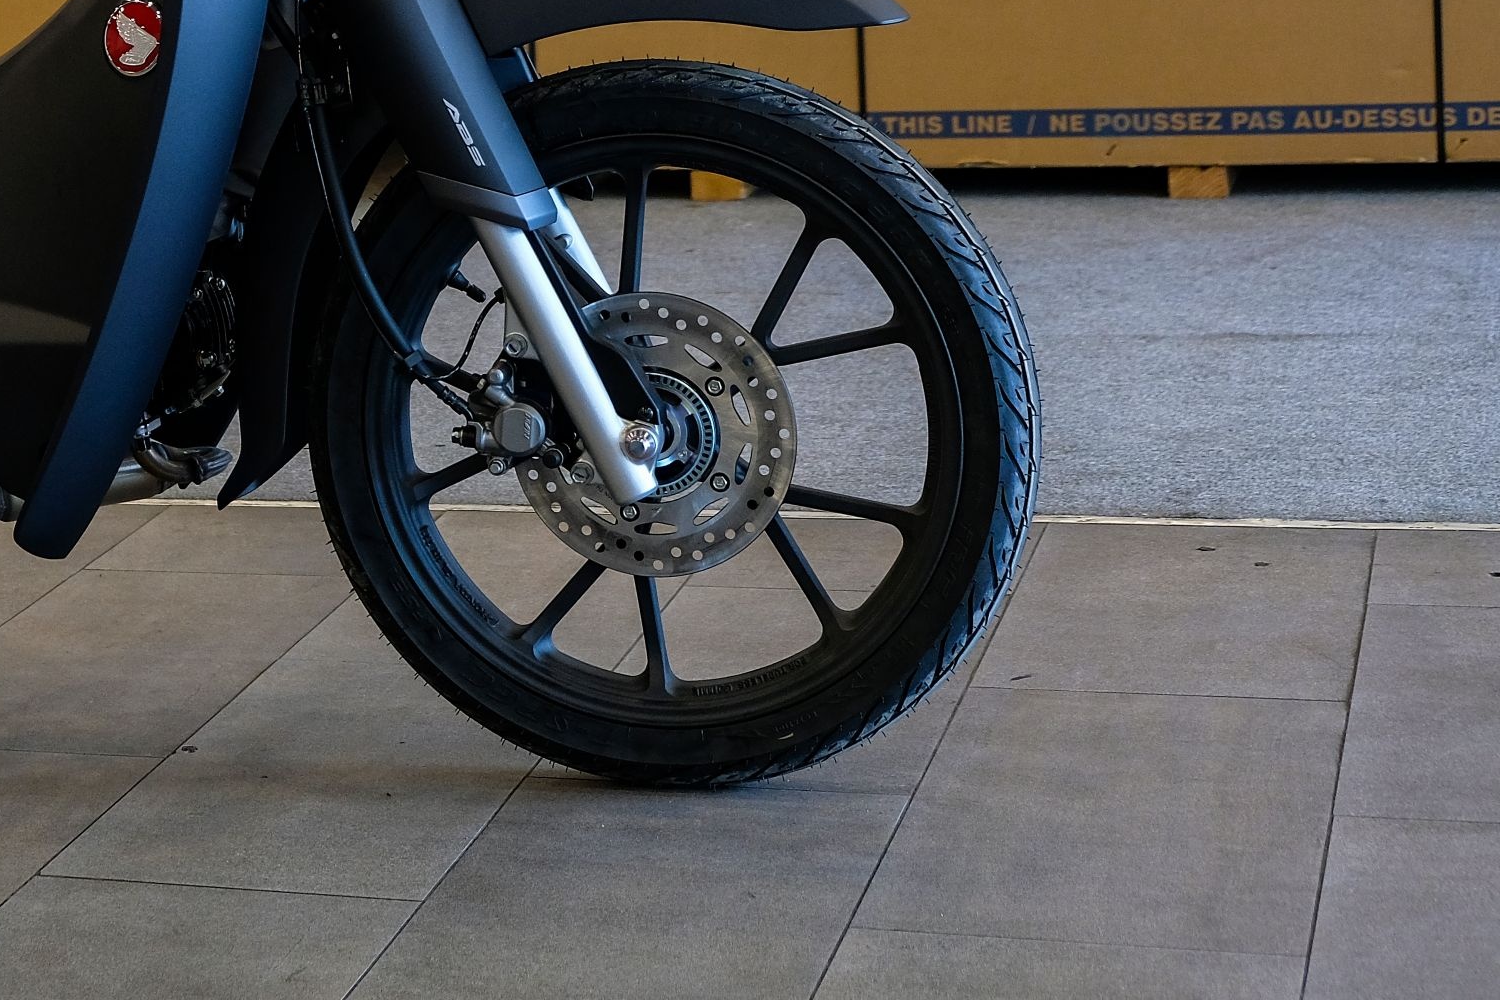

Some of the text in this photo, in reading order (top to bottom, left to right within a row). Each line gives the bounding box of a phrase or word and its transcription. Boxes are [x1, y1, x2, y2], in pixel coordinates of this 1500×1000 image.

[442, 97, 486, 167] ABS
[882, 115, 943, 135] THIS
[951, 115, 1012, 134] LINE
[1050, 114, 1086, 133] NE
[1094, 111, 1223, 133] POUSSEZ
[1231, 110, 1286, 131] PAS
[1293, 107, 1458, 130] AU-DESSUS
